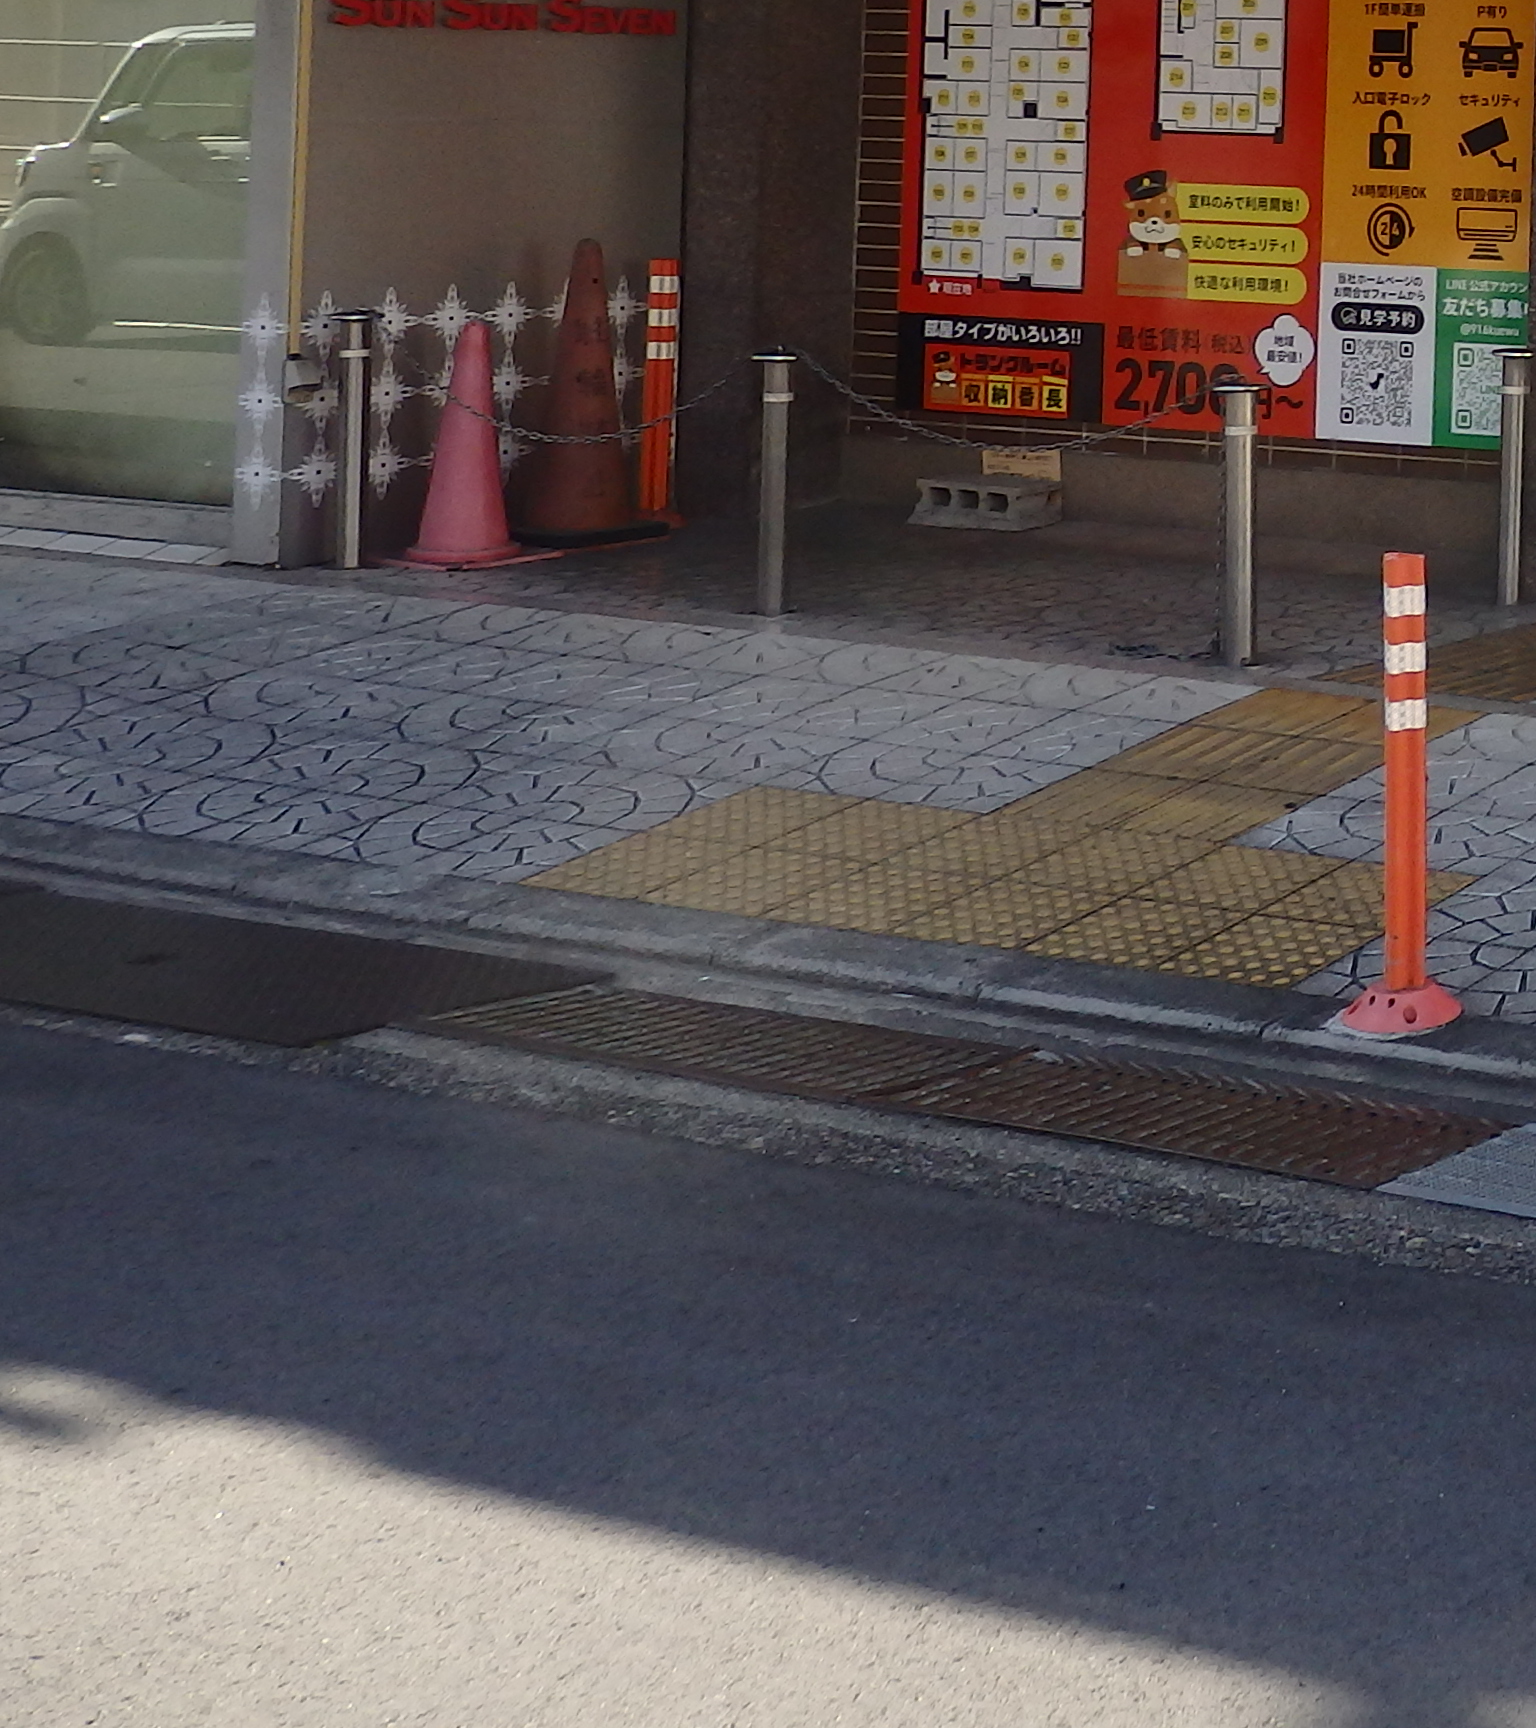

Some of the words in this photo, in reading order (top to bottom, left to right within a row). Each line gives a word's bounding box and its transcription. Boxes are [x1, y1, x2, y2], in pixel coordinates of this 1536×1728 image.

[1458, 93, 1521, 107] セキュリティ
[1359, 308, 1416, 328] 見学予約
